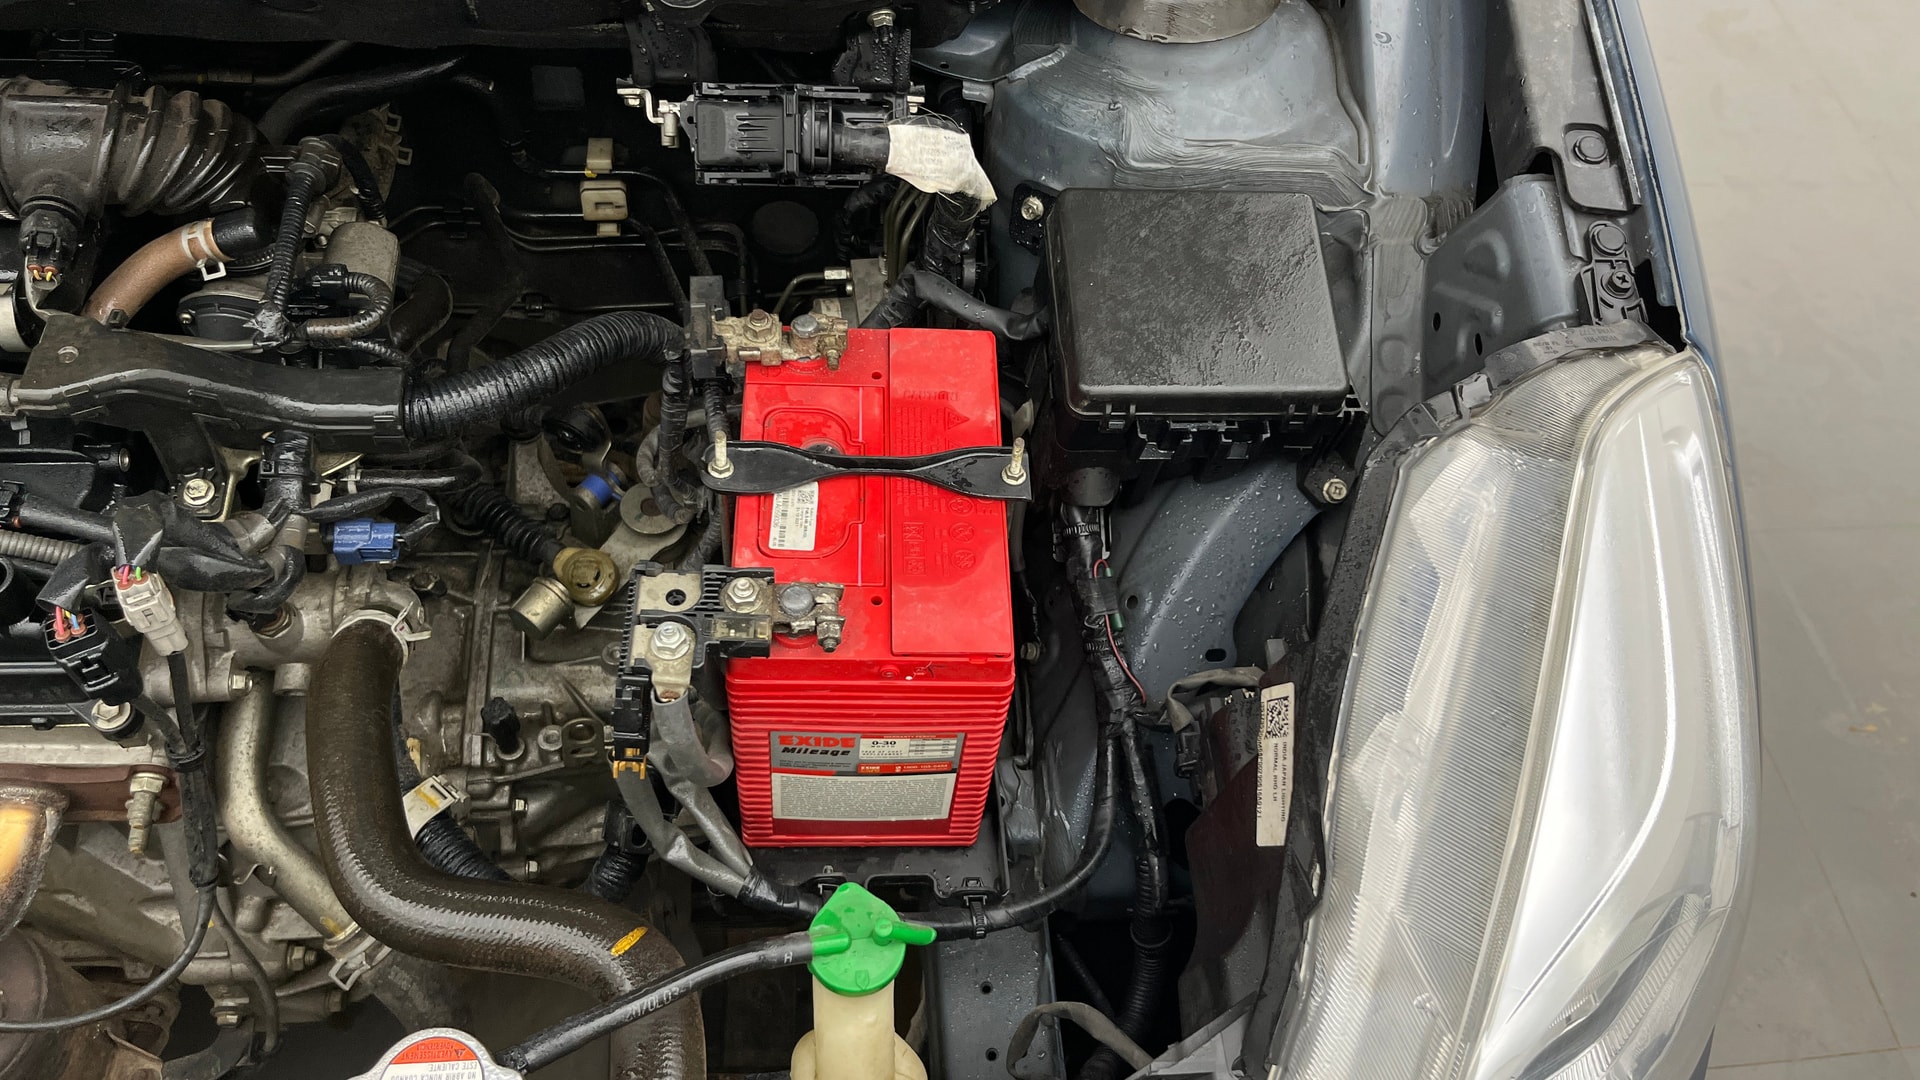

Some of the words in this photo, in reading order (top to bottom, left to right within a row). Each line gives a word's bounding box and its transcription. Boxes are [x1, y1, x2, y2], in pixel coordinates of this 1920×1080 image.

[778, 735, 856, 749] EXIDE
[781, 746, 851, 757] Mileage
[461, 1062, 478, 1070] ESTE
[467, 1071, 477, 1079] NO
